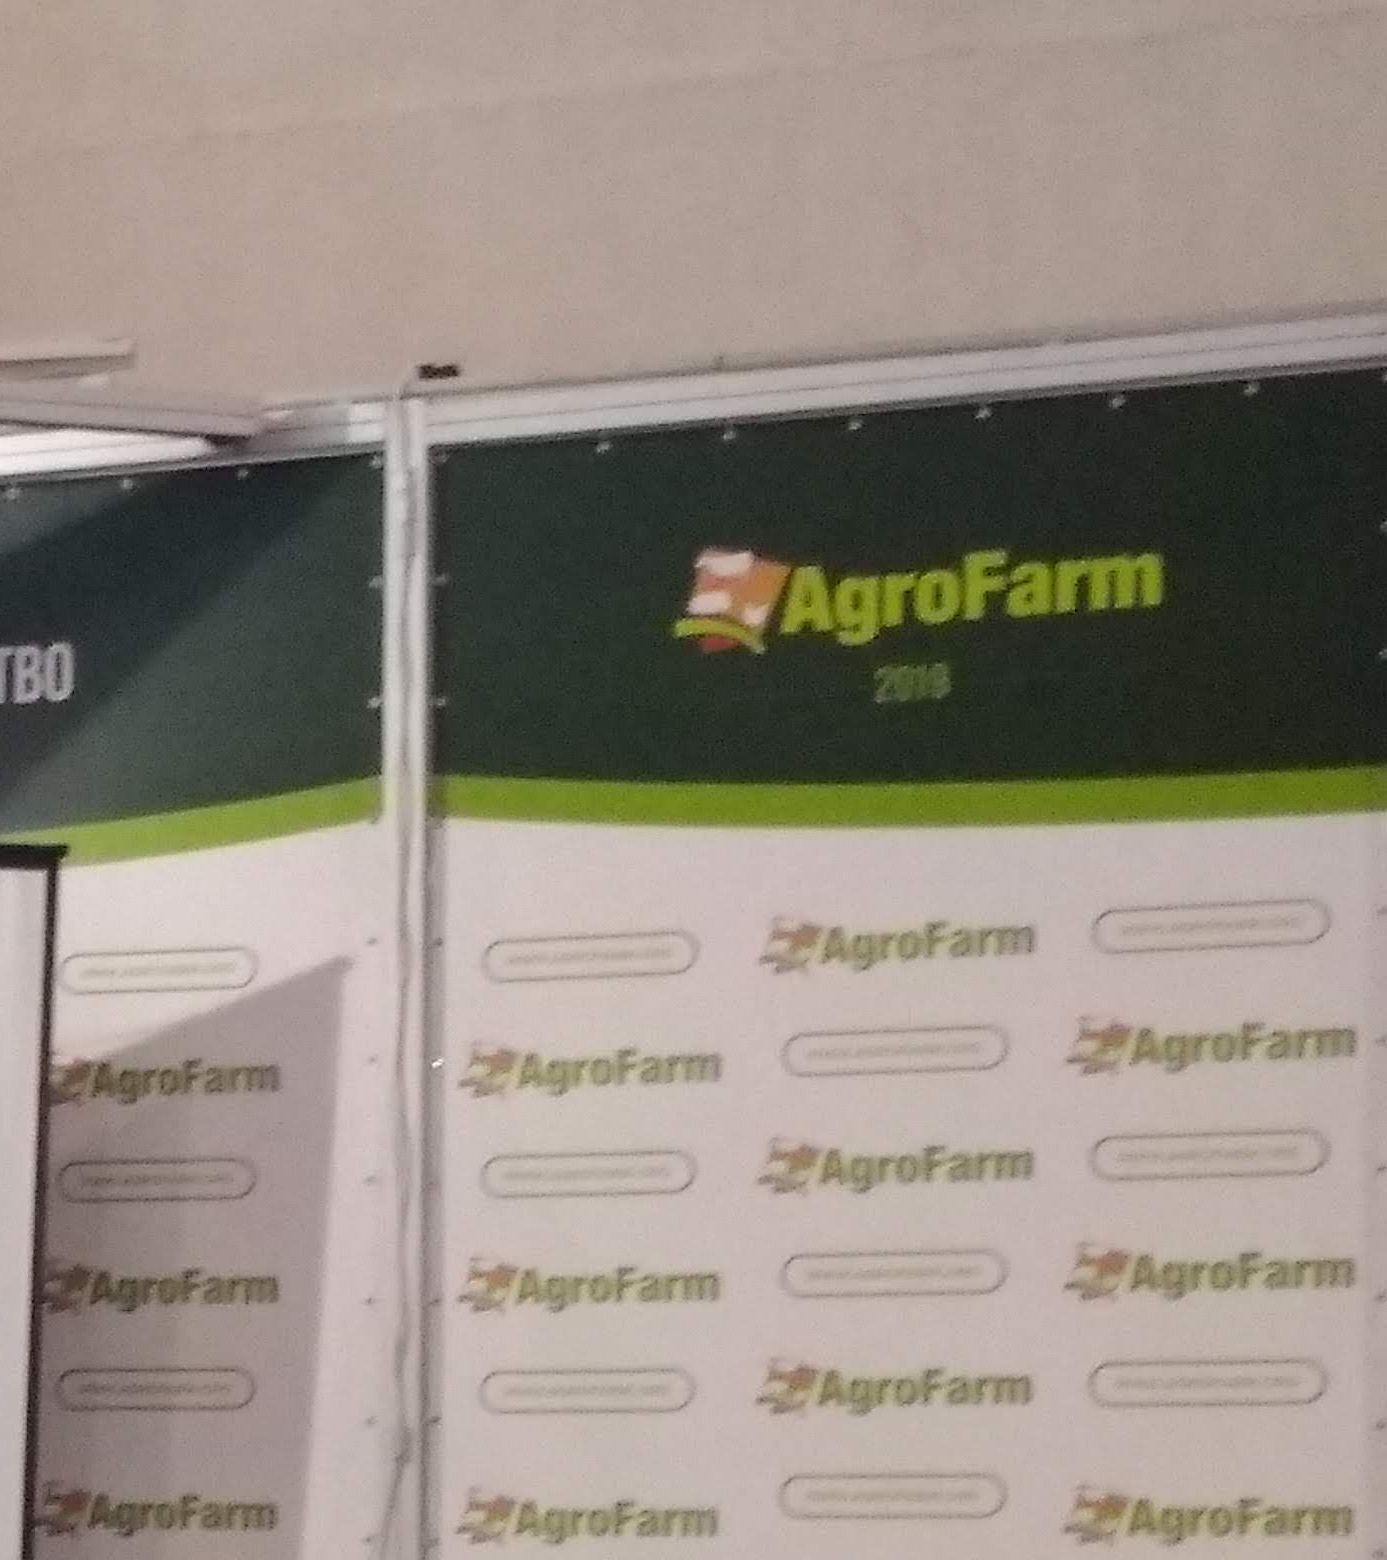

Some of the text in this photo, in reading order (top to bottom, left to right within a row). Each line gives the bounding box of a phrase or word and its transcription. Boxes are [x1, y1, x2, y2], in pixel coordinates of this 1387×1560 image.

[777, 548, 1164, 647] AgroFarm
[820, 921, 1035, 970] AgroFarm
[1129, 1021, 1356, 1074] AgroFarm
[89, 1057, 280, 1104] AgroFarm
[515, 1049, 722, 1096] AgroFarm
[819, 1145, 1033, 1193] AgroFarm
[87, 1267, 279, 1313] AgroFarm
[515, 1266, 720, 1312] AgroFarm
[1129, 1252, 1355, 1301] AgroFarm
[817, 1367, 1033, 1415] AgroFarm
[86, 1495, 279, 1536] AgroFarm
[513, 1500, 718, 1545] AgroFarm
[1127, 1497, 1355, 1544] AgroFarm
